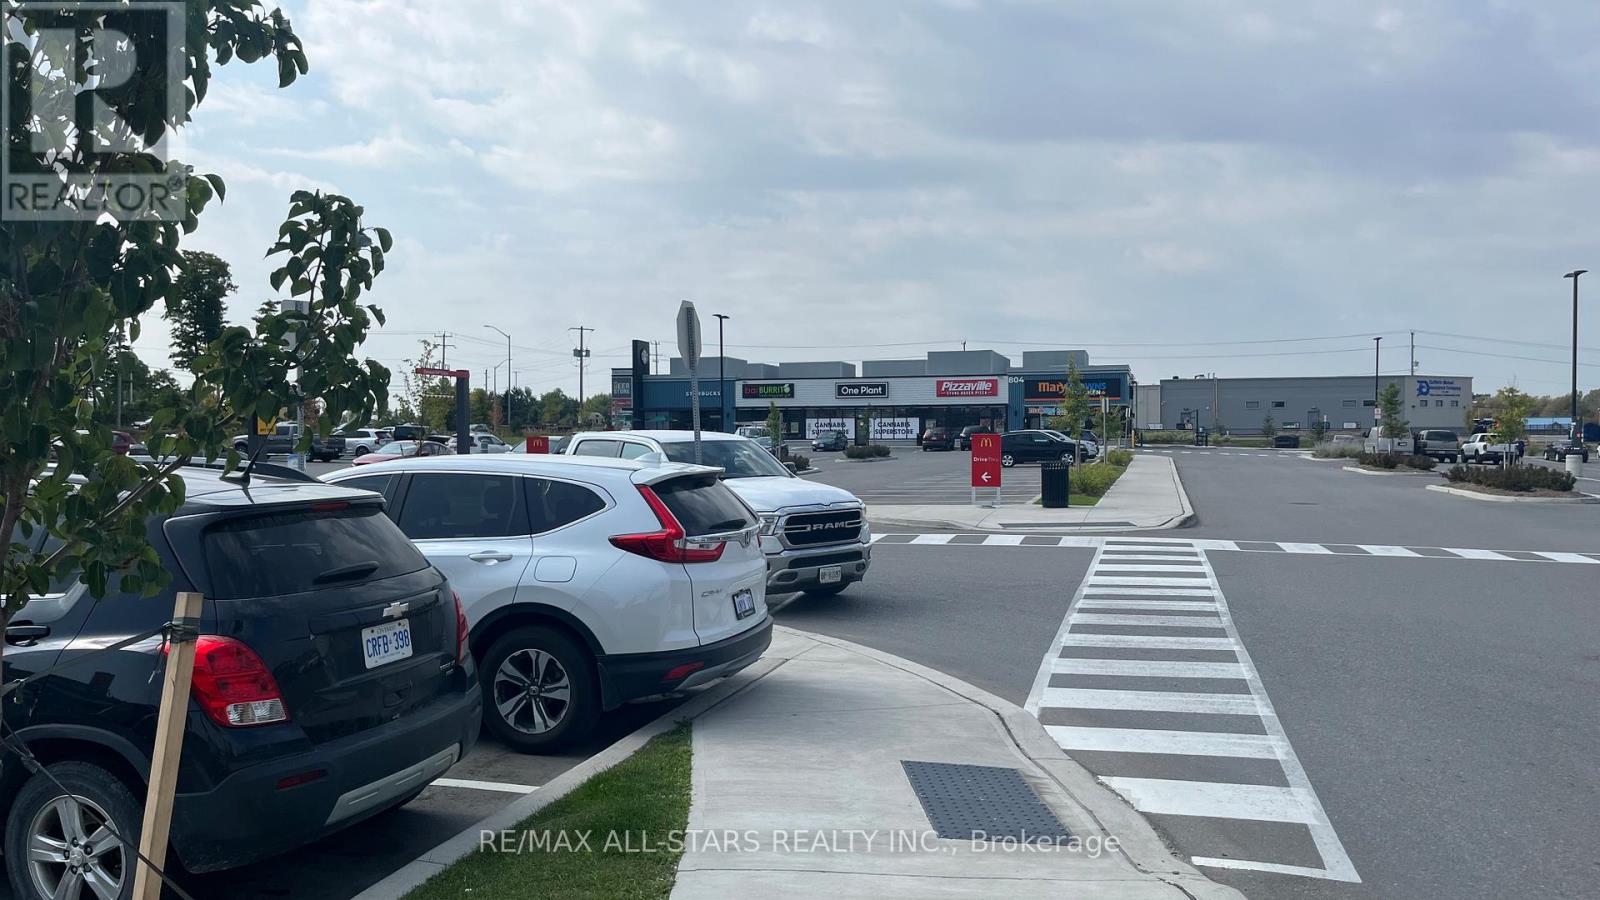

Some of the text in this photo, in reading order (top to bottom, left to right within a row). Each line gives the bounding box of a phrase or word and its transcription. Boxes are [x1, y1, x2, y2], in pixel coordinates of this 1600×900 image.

[841, 386, 883, 395] One Plant
[941, 381, 993, 391] Pizzaville
[812, 522, 846, 531] RAM
[393, 629, 410, 650] 398
